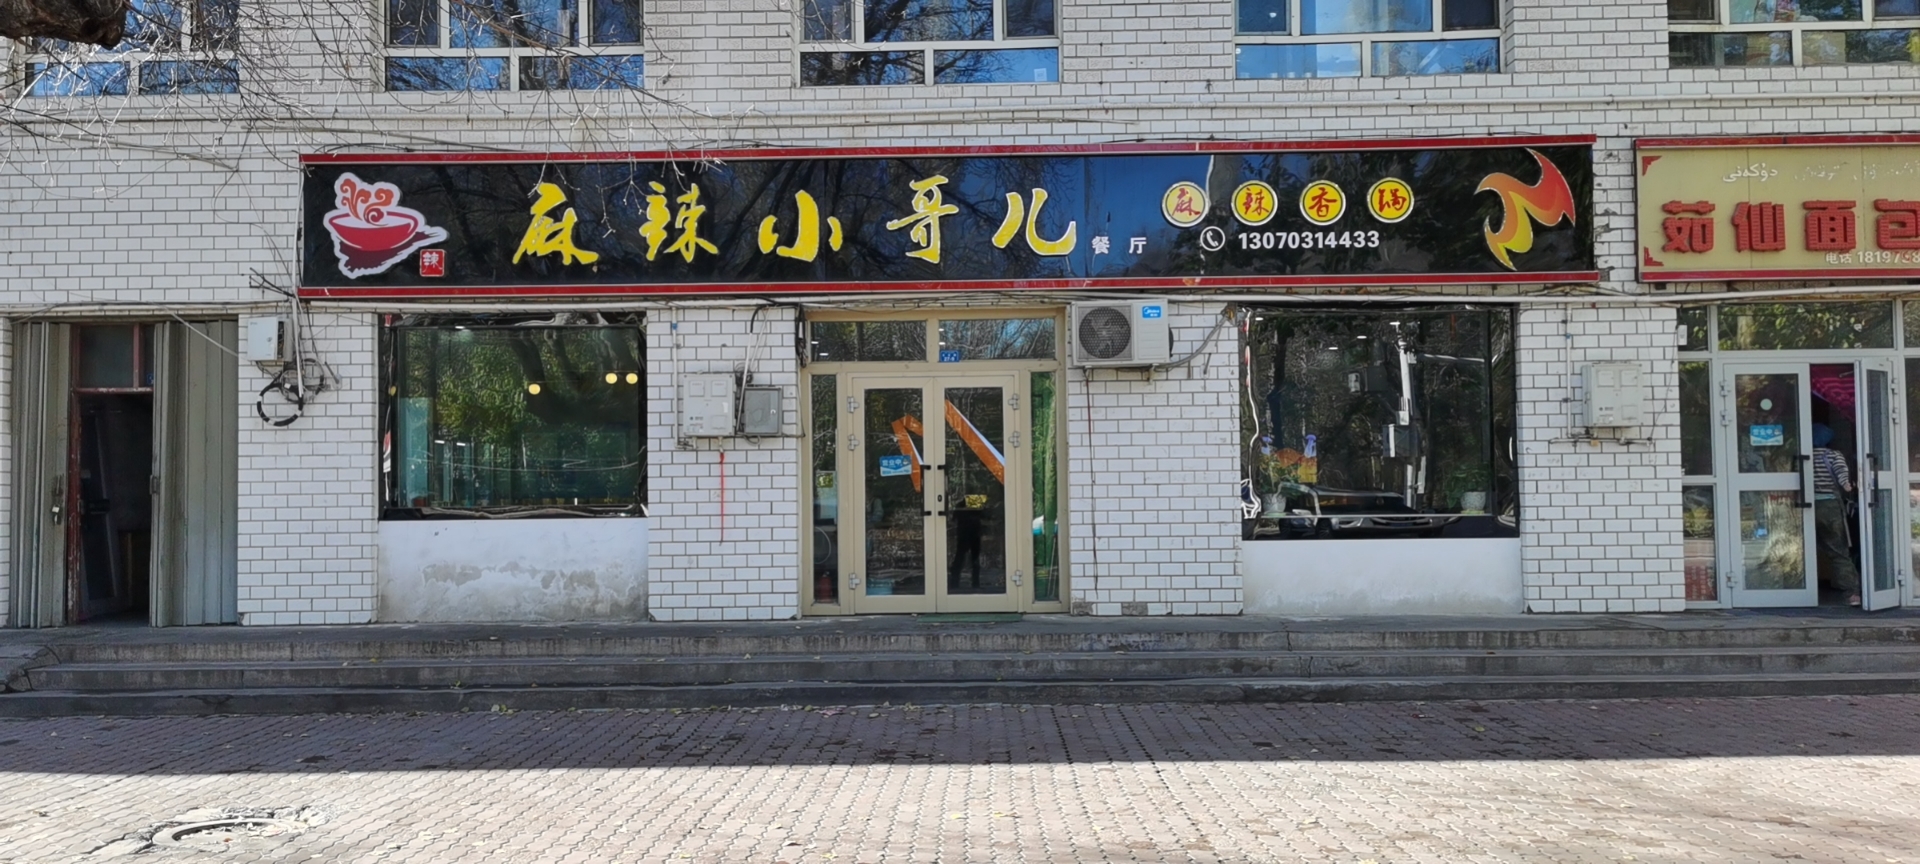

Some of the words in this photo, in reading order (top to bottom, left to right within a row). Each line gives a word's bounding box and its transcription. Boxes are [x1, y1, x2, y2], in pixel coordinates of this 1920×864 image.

[1170, 186, 1408, 218] 麻辣香锅
[512, 174, 1077, 264] 麻辣小哥儿
[1091, 235, 1147, 255] 餐厅
[1238, 231, 1380, 250] 13070314433
